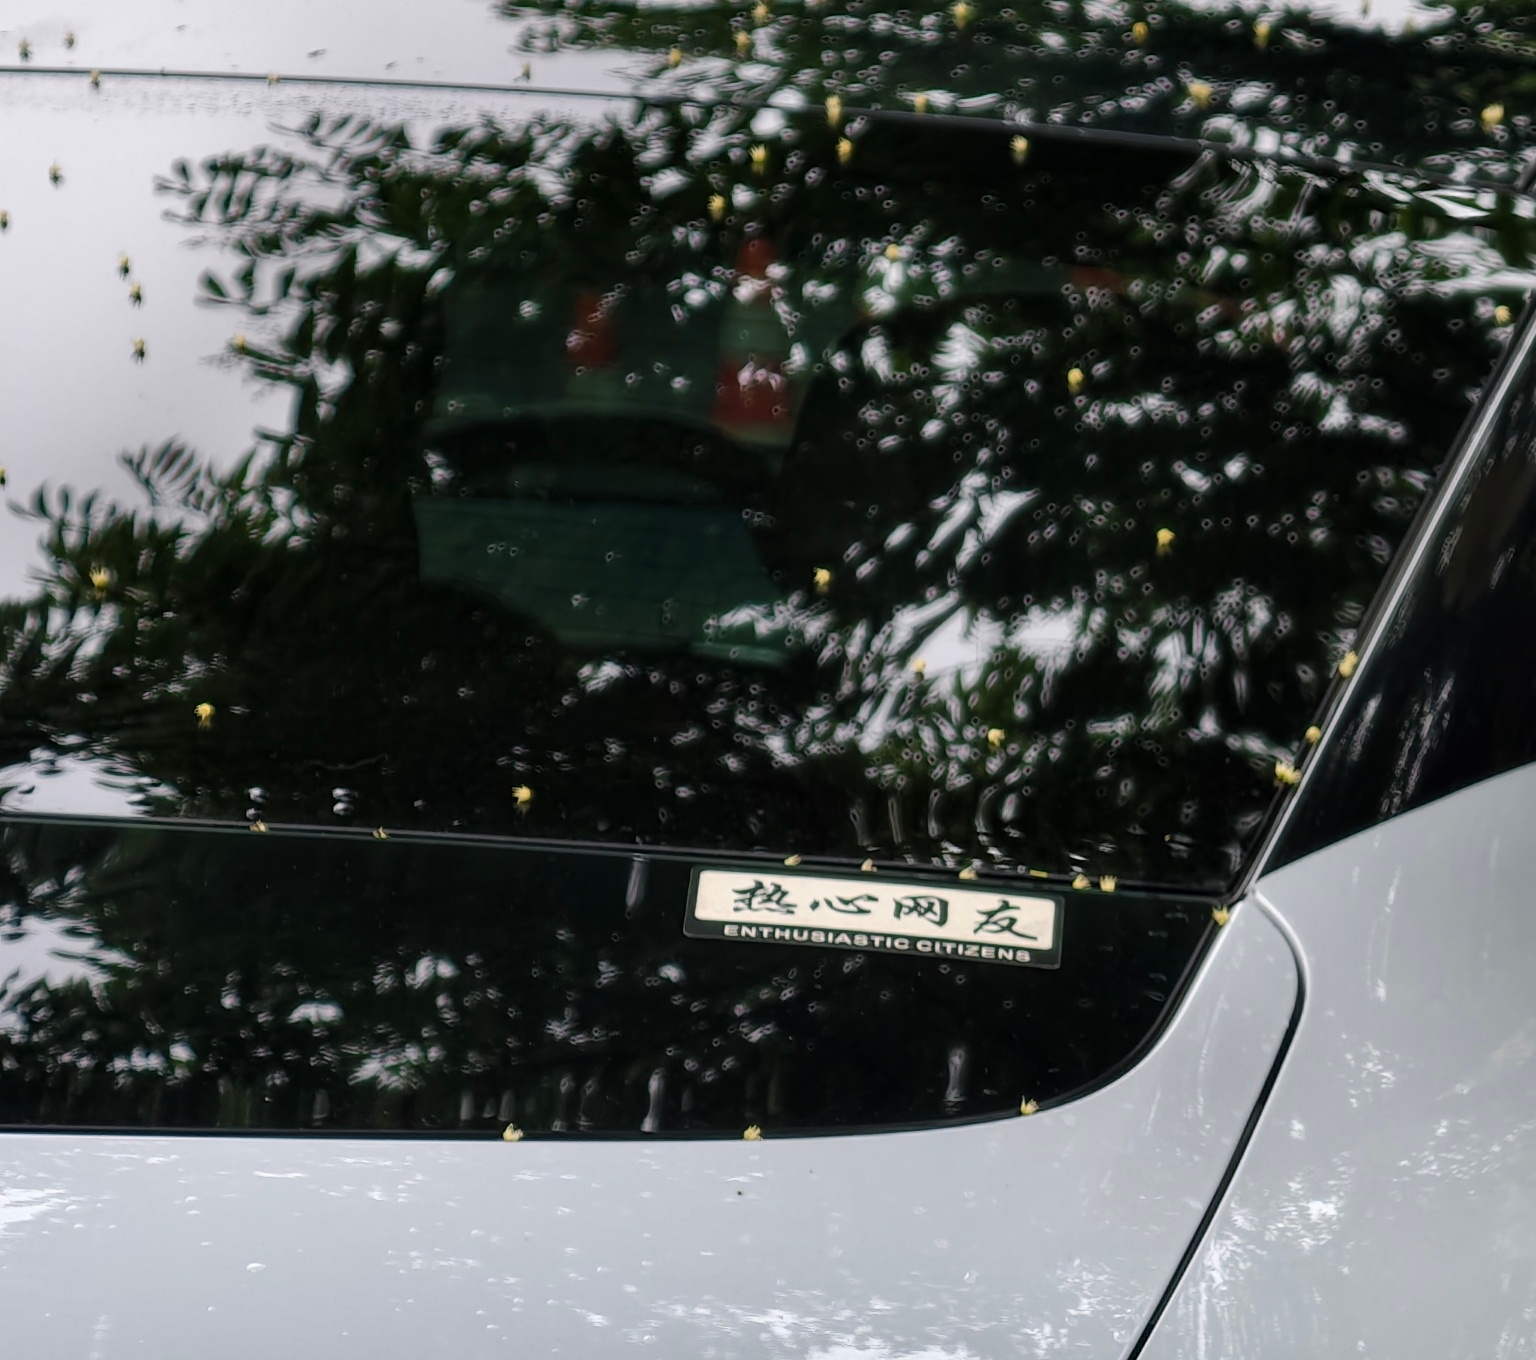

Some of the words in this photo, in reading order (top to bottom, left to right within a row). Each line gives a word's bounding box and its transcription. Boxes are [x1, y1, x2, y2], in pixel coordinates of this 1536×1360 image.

[732, 880, 1038, 941] 热心网友
[723, 924, 910, 952] ENTHUSIASTIC
[916, 938, 1032, 964] CITIZENS
